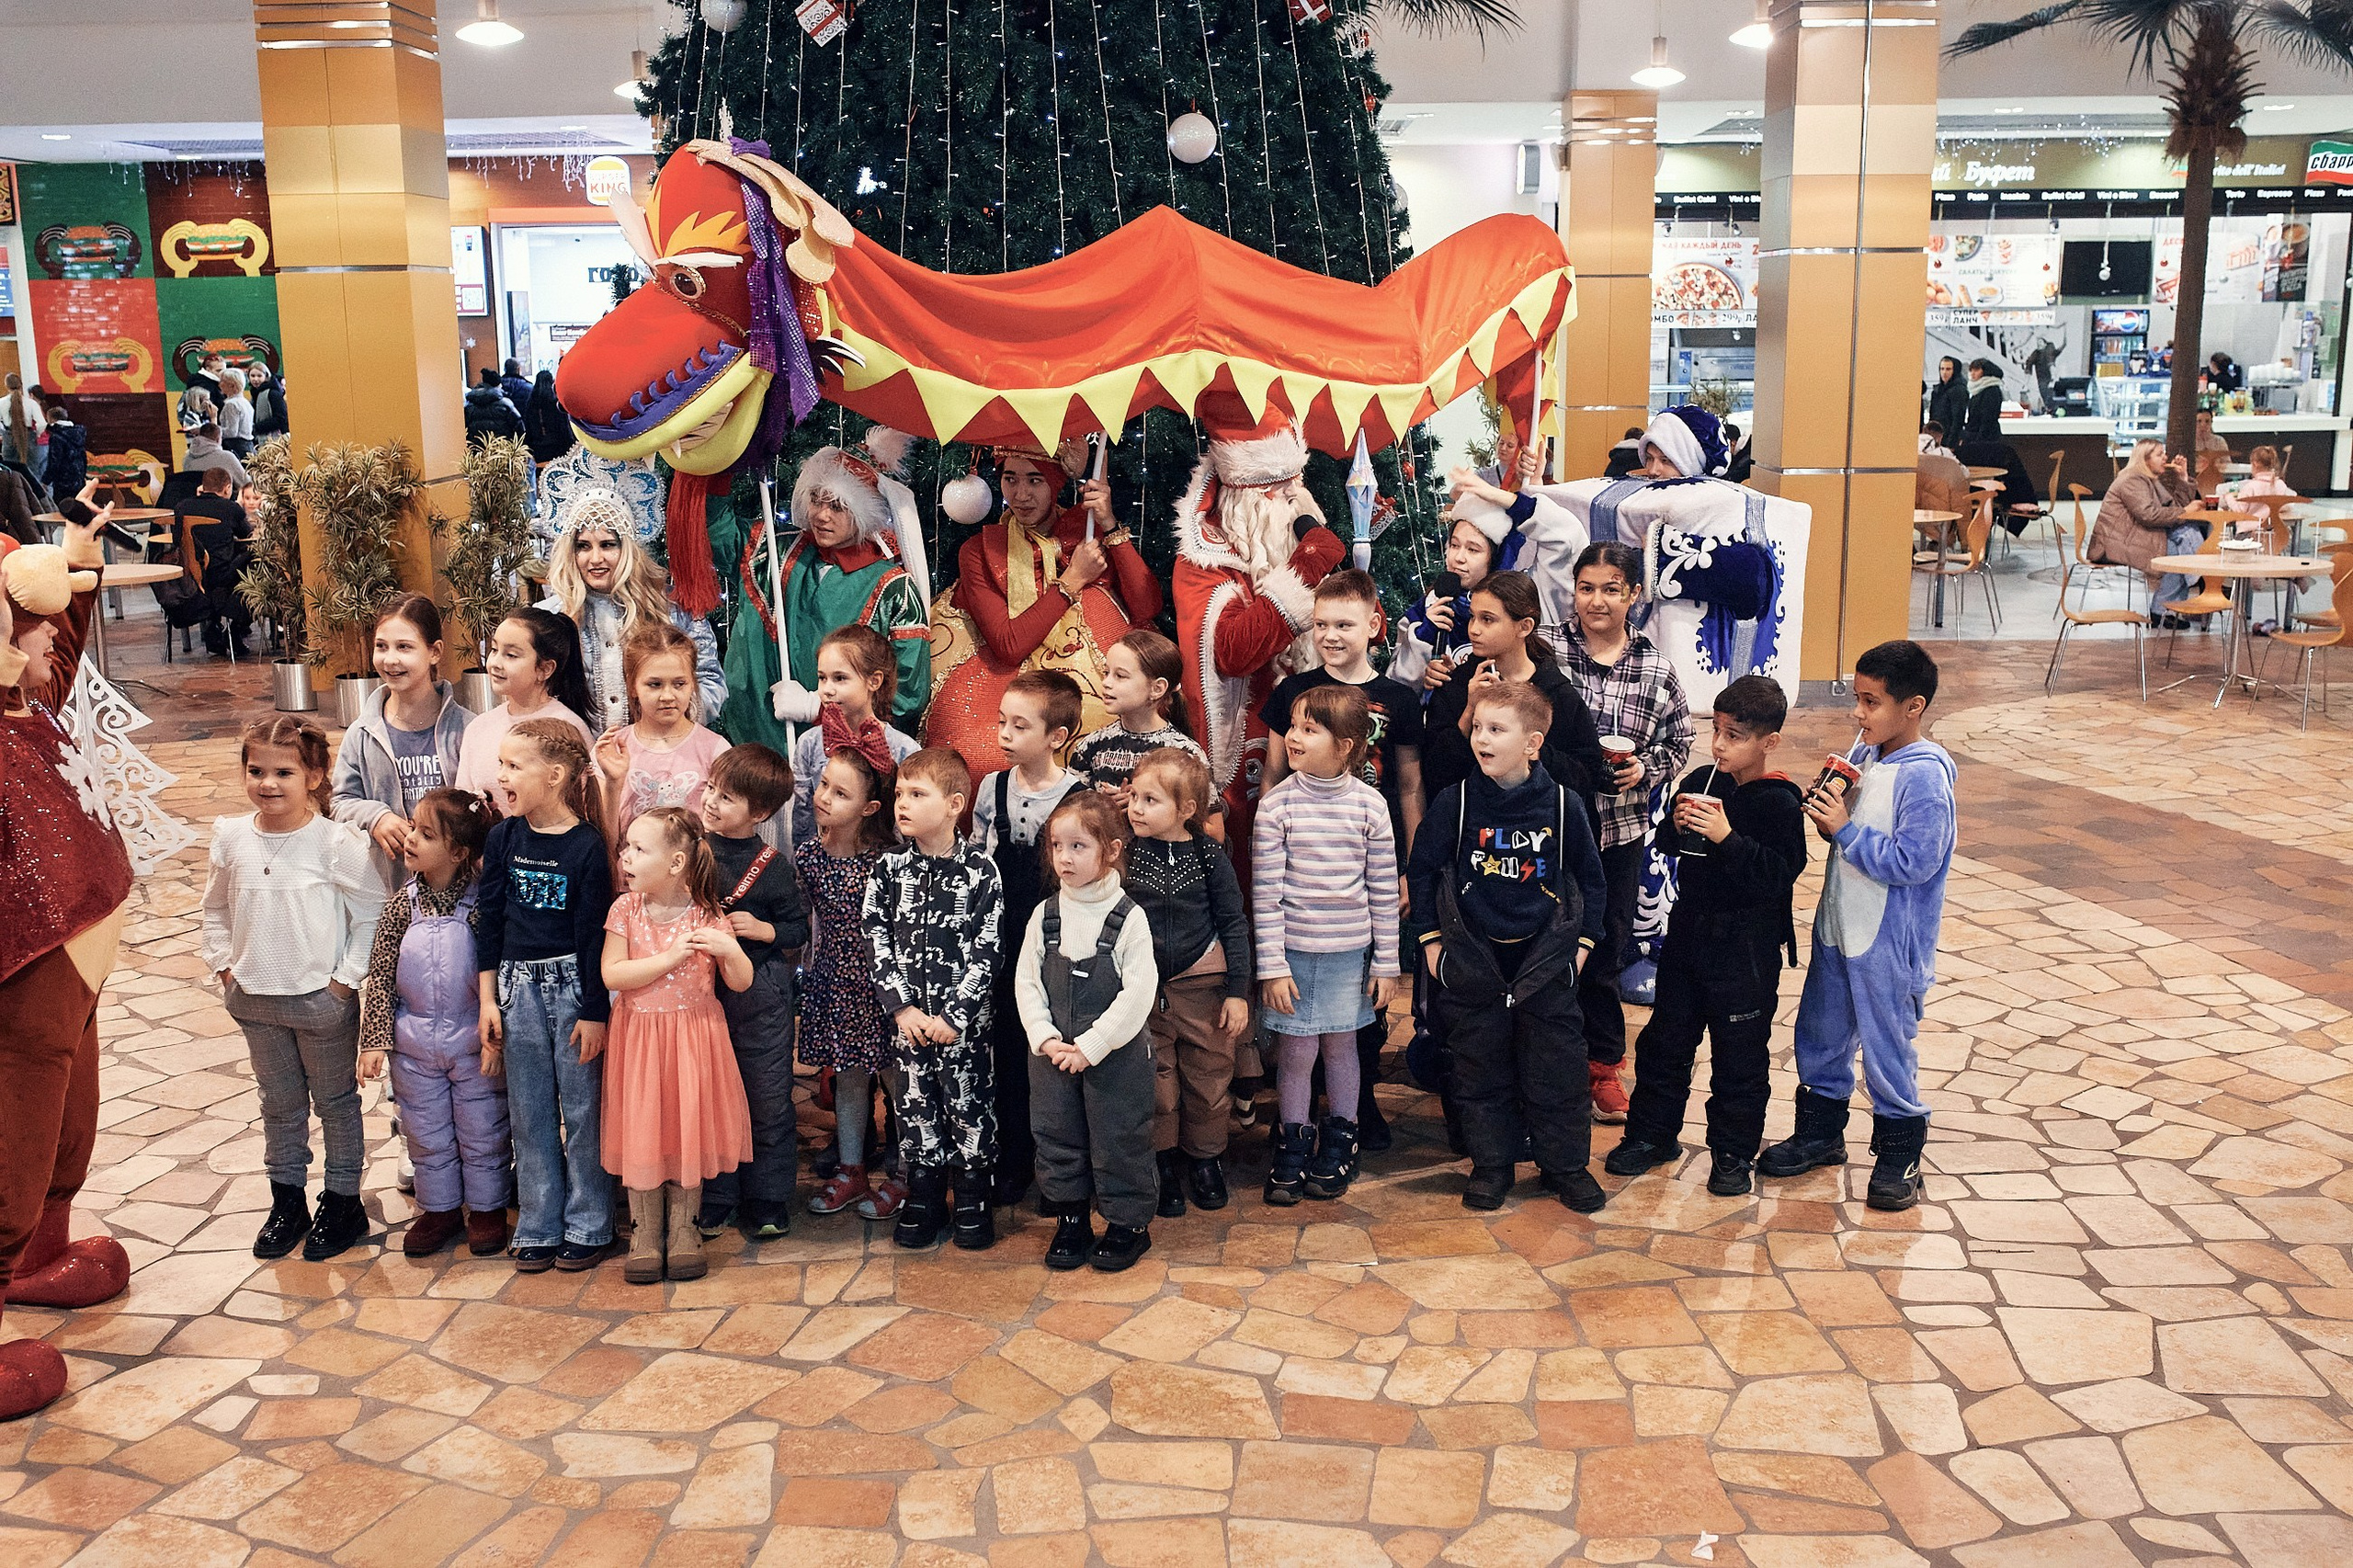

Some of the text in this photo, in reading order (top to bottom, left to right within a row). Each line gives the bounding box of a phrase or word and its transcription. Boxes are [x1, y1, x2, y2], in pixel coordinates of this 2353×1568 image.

[1963, 161, 2035, 187] Буфет
[590, 182, 627, 193] KING
[1721, 242, 1743, 250] ДЕНЬ
[1652, 314, 1675, 323] МБО
[395, 755, 441, 777] YOU'RE
[401, 776, 442, 787] otally
[513, 855, 559, 867] Mademoiselle
